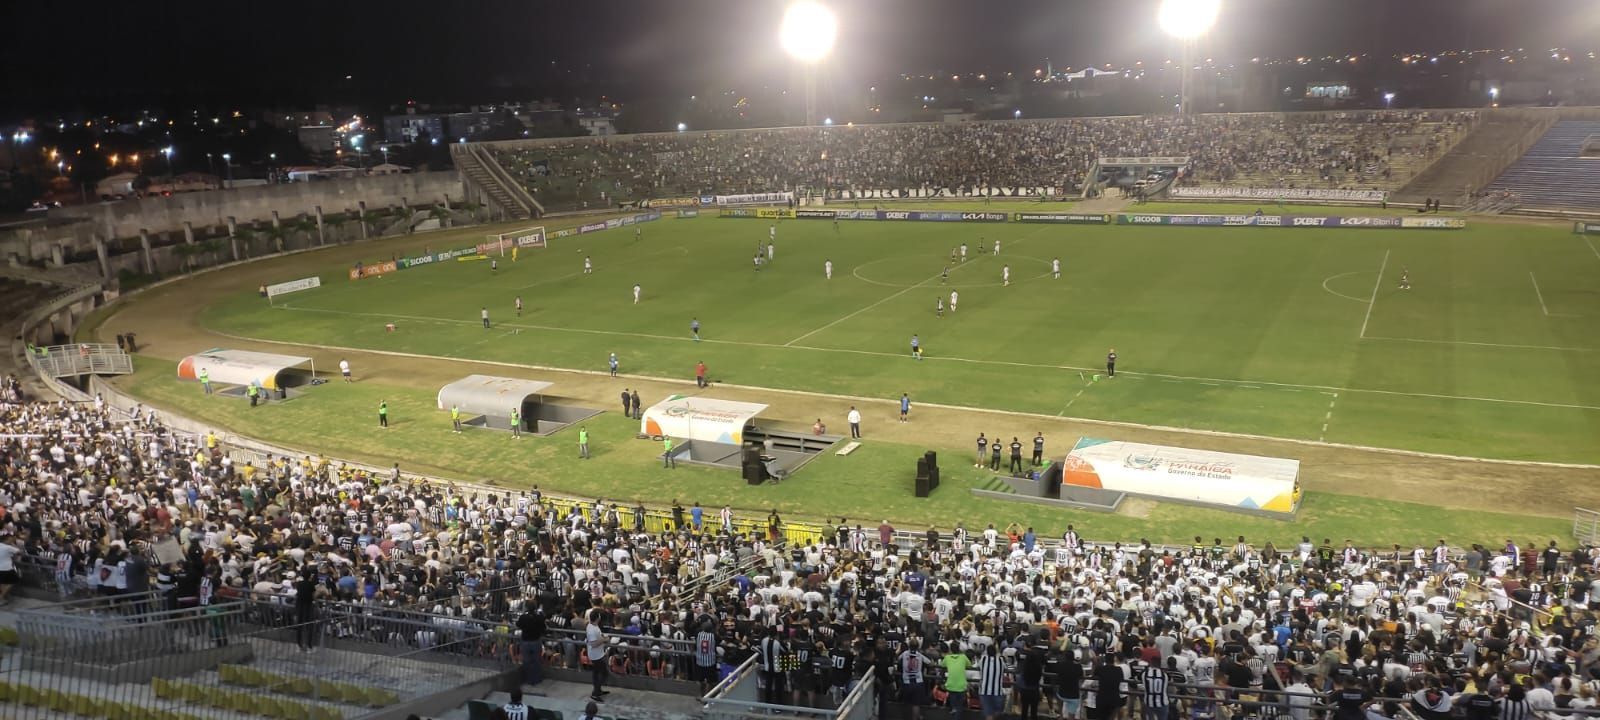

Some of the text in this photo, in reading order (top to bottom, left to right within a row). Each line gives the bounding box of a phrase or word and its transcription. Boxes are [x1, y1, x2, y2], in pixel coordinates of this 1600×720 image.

[1293, 217, 1327, 226] 1XBET
[1340, 217, 1370, 225] KIA
[410, 255, 433, 266] SICOOB
[1064, 624, 1076, 635] 10
[1148, 677, 1163, 693] 10
